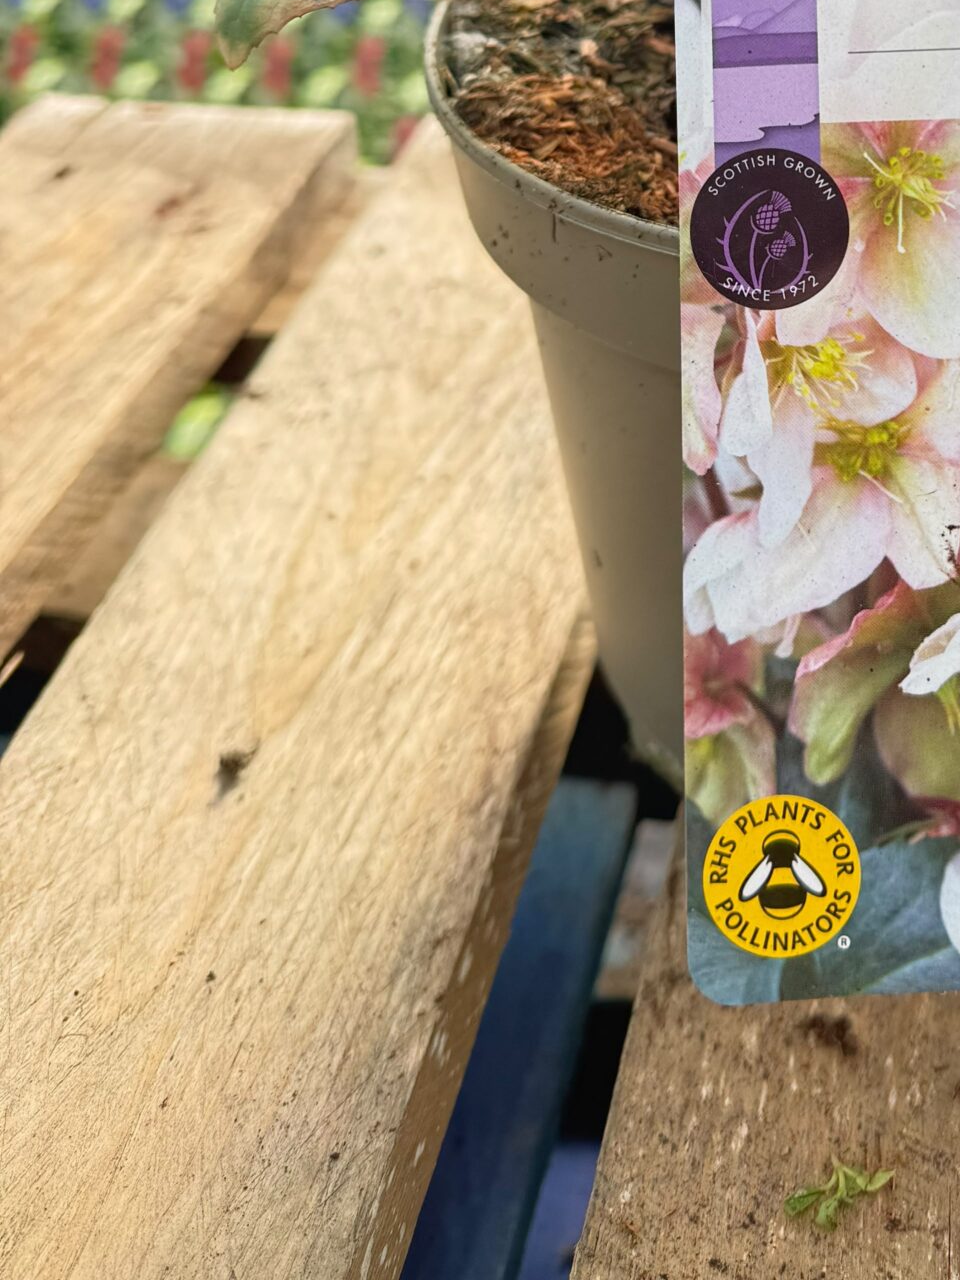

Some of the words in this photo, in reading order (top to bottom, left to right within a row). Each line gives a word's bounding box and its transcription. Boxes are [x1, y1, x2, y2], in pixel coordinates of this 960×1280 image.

[708, 155, 775, 196] SCOTTISH
[784, 157, 836, 201] GROWN
[723, 277, 770, 302] SINCE
[781, 275, 819, 300] 1972
[710, 836, 736, 884] RHS
[734, 801, 826, 835] PLANTS
[826, 829, 854, 877] FOR
[715, 889, 852, 951] POLLINATORS
